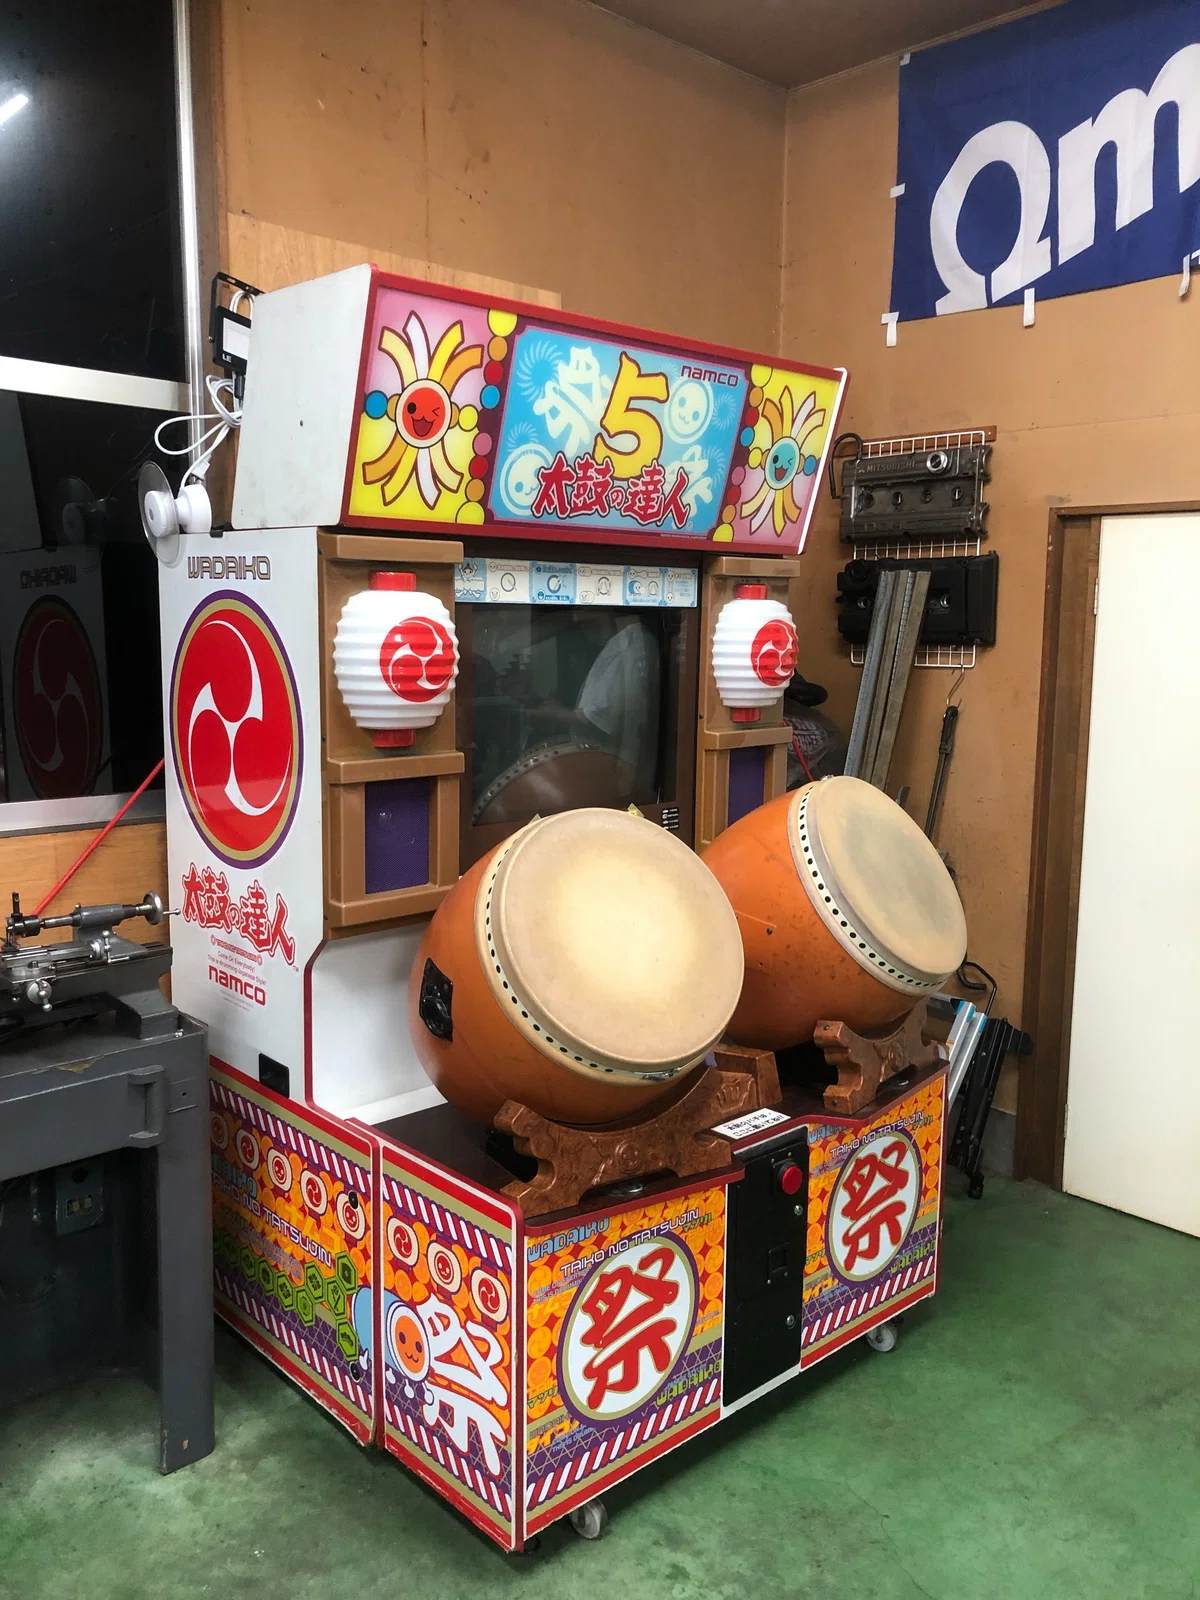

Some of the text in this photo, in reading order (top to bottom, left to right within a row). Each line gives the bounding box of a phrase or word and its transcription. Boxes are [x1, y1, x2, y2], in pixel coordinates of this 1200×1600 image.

[681, 364, 739, 387] namco
[531, 452, 690, 529] 太鼓の達人
[866, 460, 916, 473] MITSUBISHI
[187, 555, 271, 581] WADAIKO
[182, 862, 296, 966] 太鼓の達人
[208, 964, 267, 1007] namco
[829, 1110, 925, 1158] TAIKO NO TATSUJIN
[841, 1140, 909, 1272] 祭
[243, 1193, 261, 1218] NO
[262, 1206, 333, 1269] TATSUJIN
[527, 1217, 609, 1263] WADAIKO
[561, 1207, 700, 1277] TAIKO NO TATSUJIN
[580, 1247, 679, 1411] 祭
[656, 1358, 723, 1406] WADAIKO
